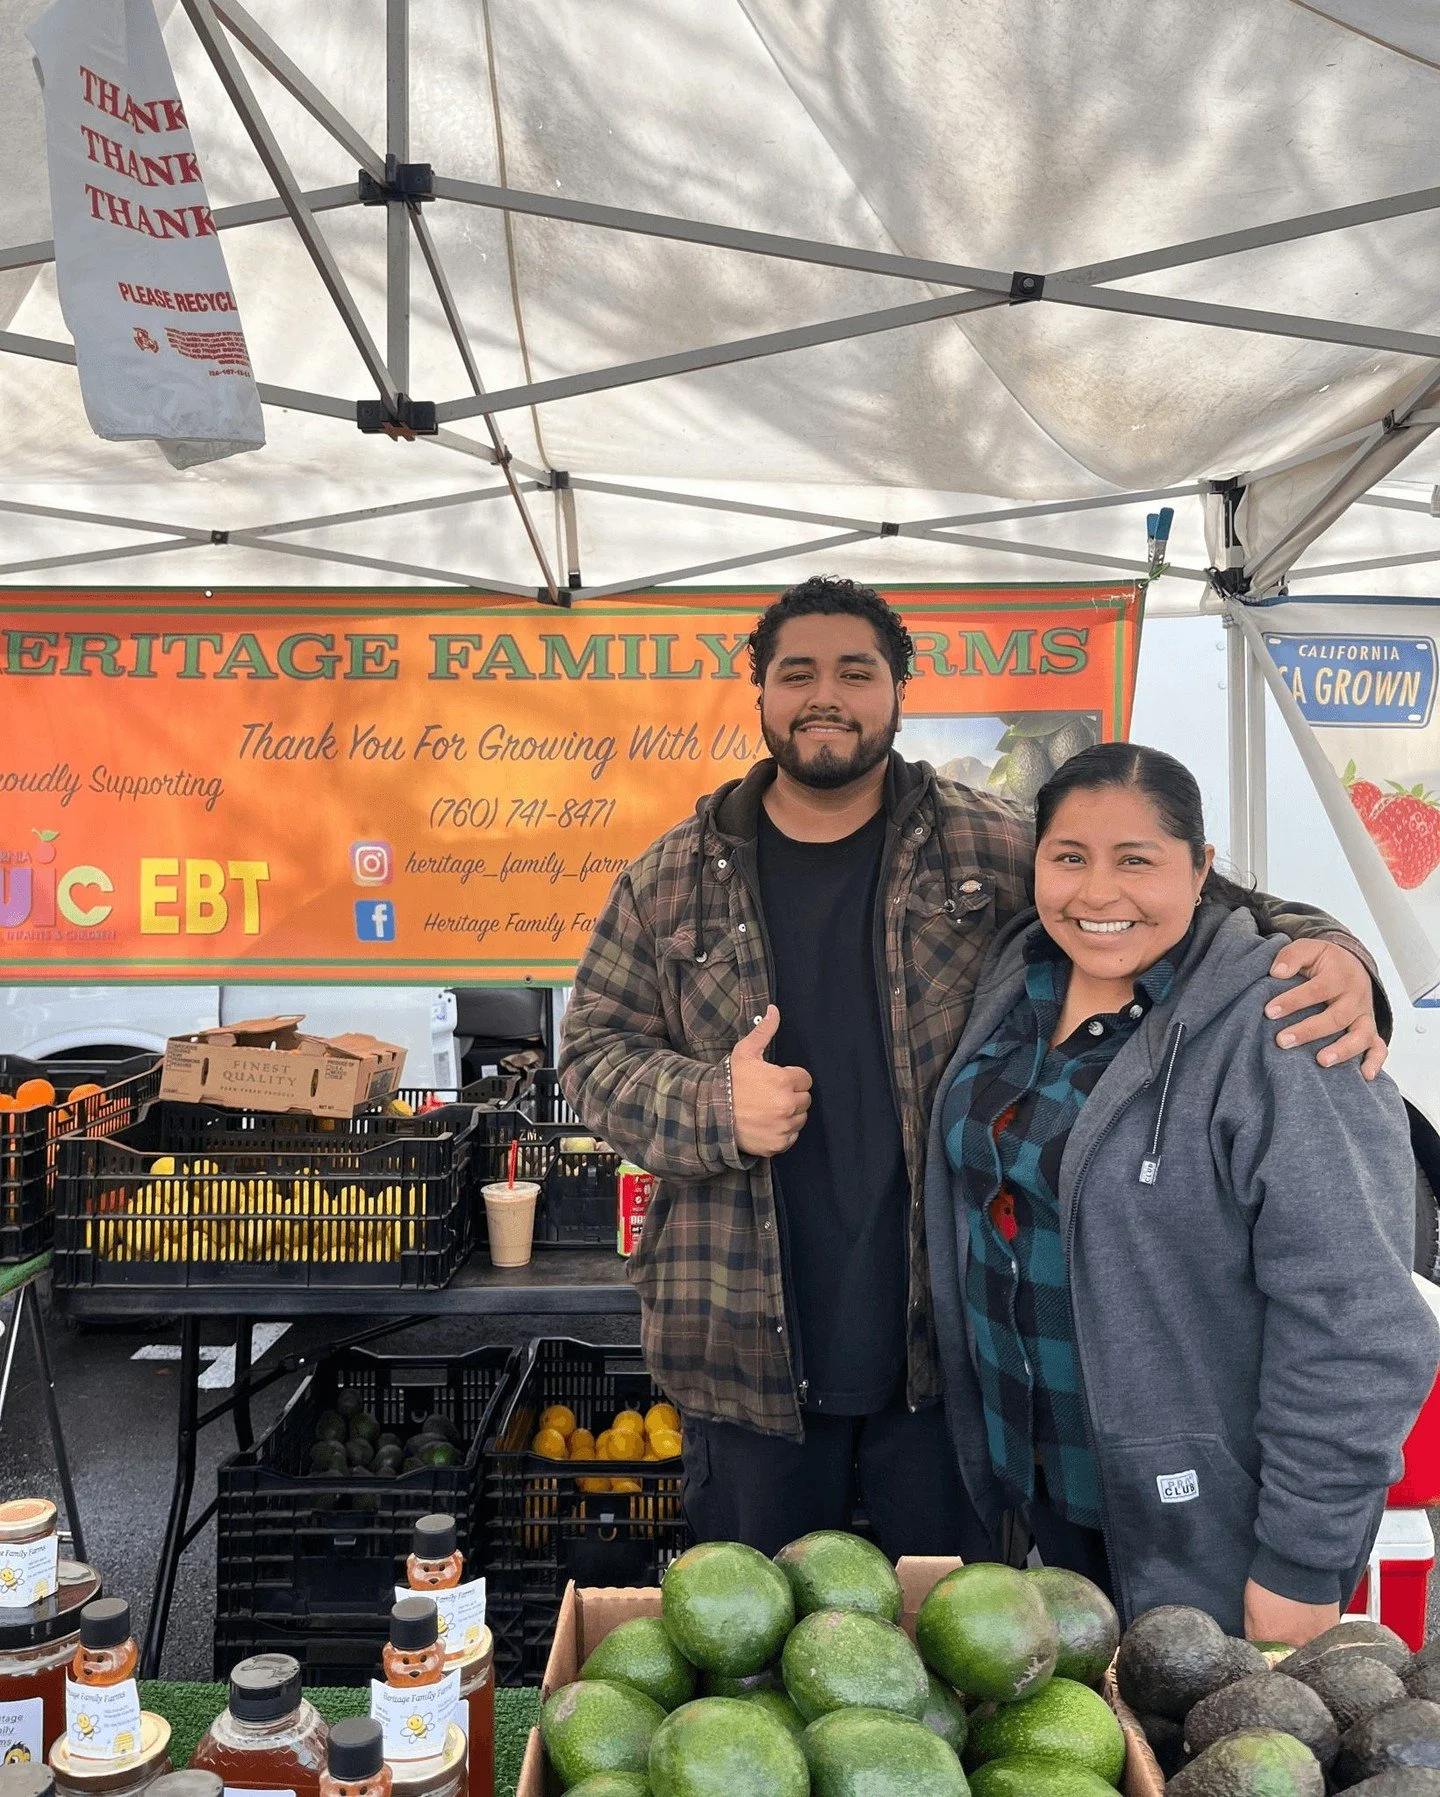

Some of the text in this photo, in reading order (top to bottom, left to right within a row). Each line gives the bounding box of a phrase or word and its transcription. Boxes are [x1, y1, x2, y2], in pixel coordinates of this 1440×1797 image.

[79, 65, 190, 134] THANK
[80, 124, 203, 187] THANK
[85, 183, 218, 239] THANK
[118, 282, 238, 313] PLEASE RECYCL
[0, 627, 1089, 680] ERITAGE FAMILY RMS
[1298, 644, 1400, 661] CALIFORNIA
[1315, 666, 1421, 707] GROWN
[239, 721, 339, 760] Thank
[349, 723, 406, 760] You
[413, 723, 468, 760] For
[478, 723, 618, 781] Growing
[628, 722, 701, 760] With
[89, 765, 224, 812] Supporting
[430, 797, 617, 829] (760) 741-8471
[404, 851, 629, 885] heritage_family_farm
[140, 857, 270, 935] EBT
[424, 912, 500, 941] Heritage
[504, 912, 565, 942] Family
[223, 1069, 297, 1087] QUALITY
[234, 1060, 291, 1074] FINEST
[1164, 1483, 1195, 1496] CLUB
